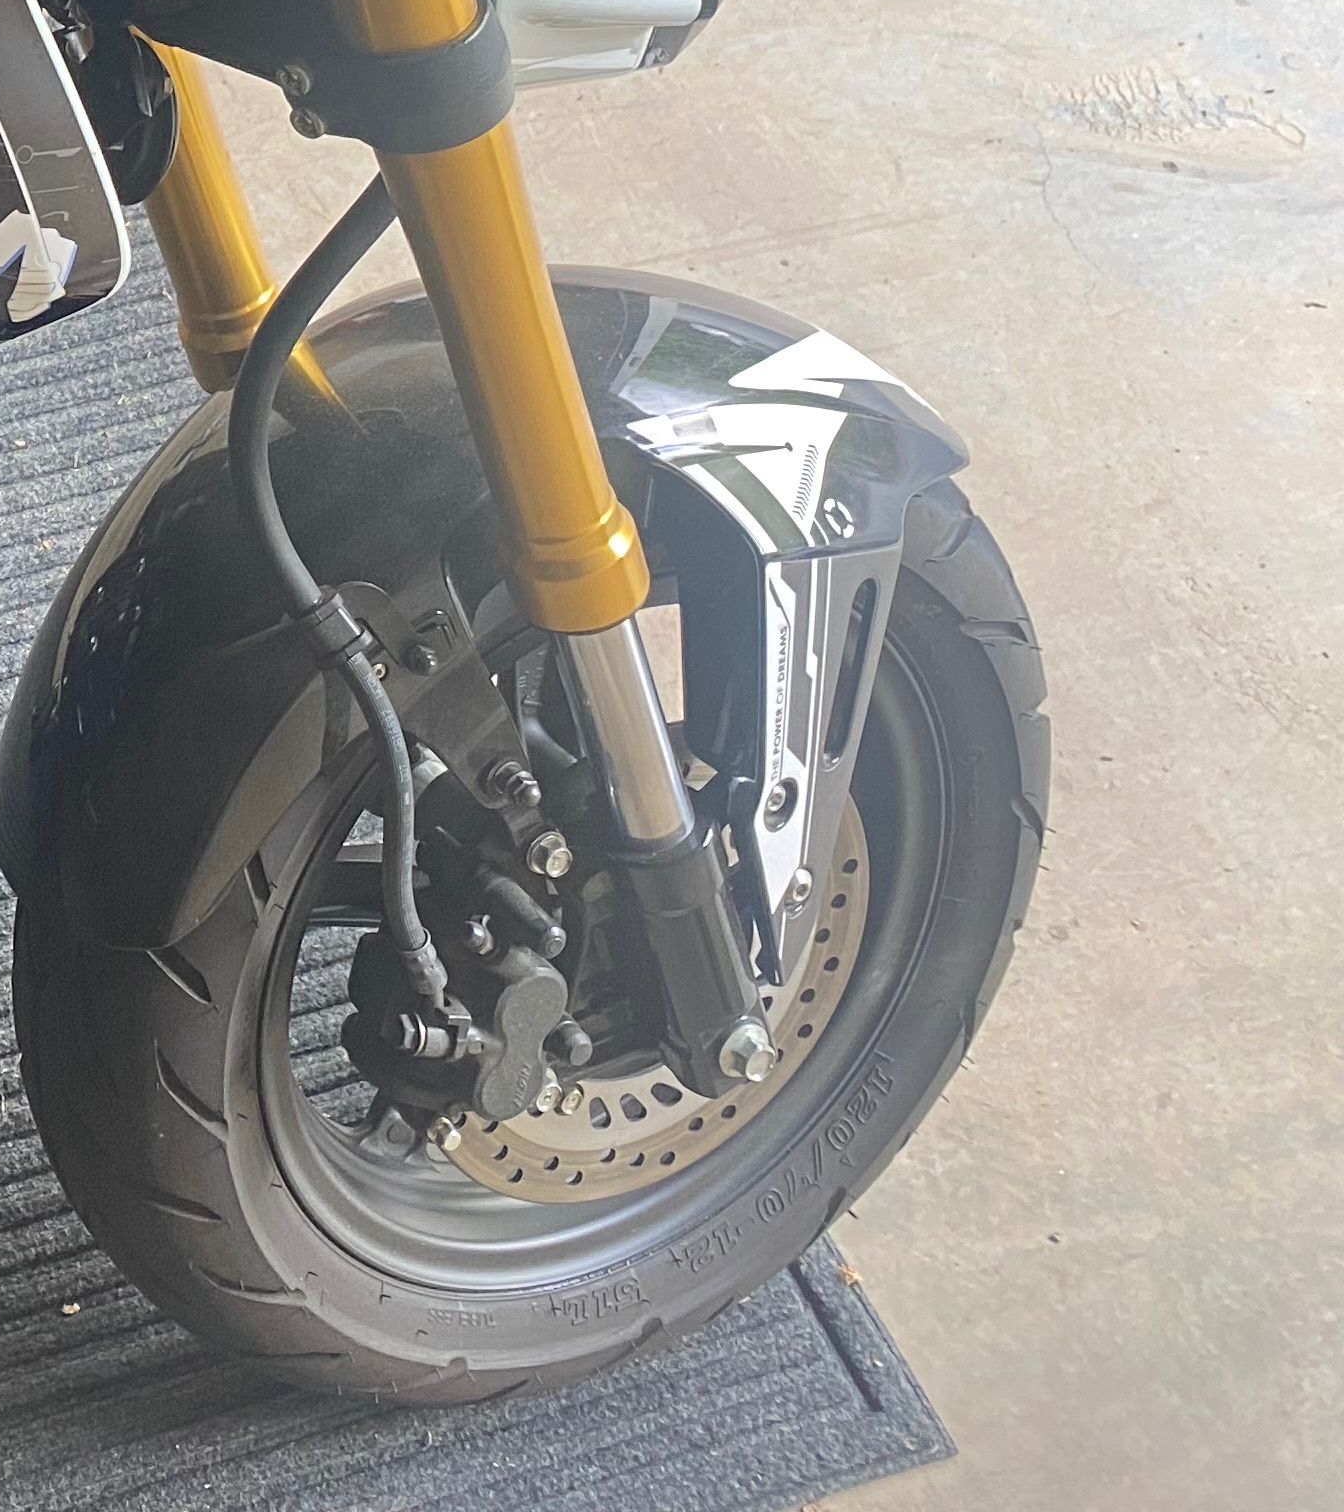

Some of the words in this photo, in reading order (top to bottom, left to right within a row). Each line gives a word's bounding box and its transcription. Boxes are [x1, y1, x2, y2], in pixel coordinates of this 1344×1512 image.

[778, 625, 788, 683] DREAMS
[776, 685, 784, 704] OF
[773, 707, 783, 755] POWER
[771, 758, 780, 782] THE
